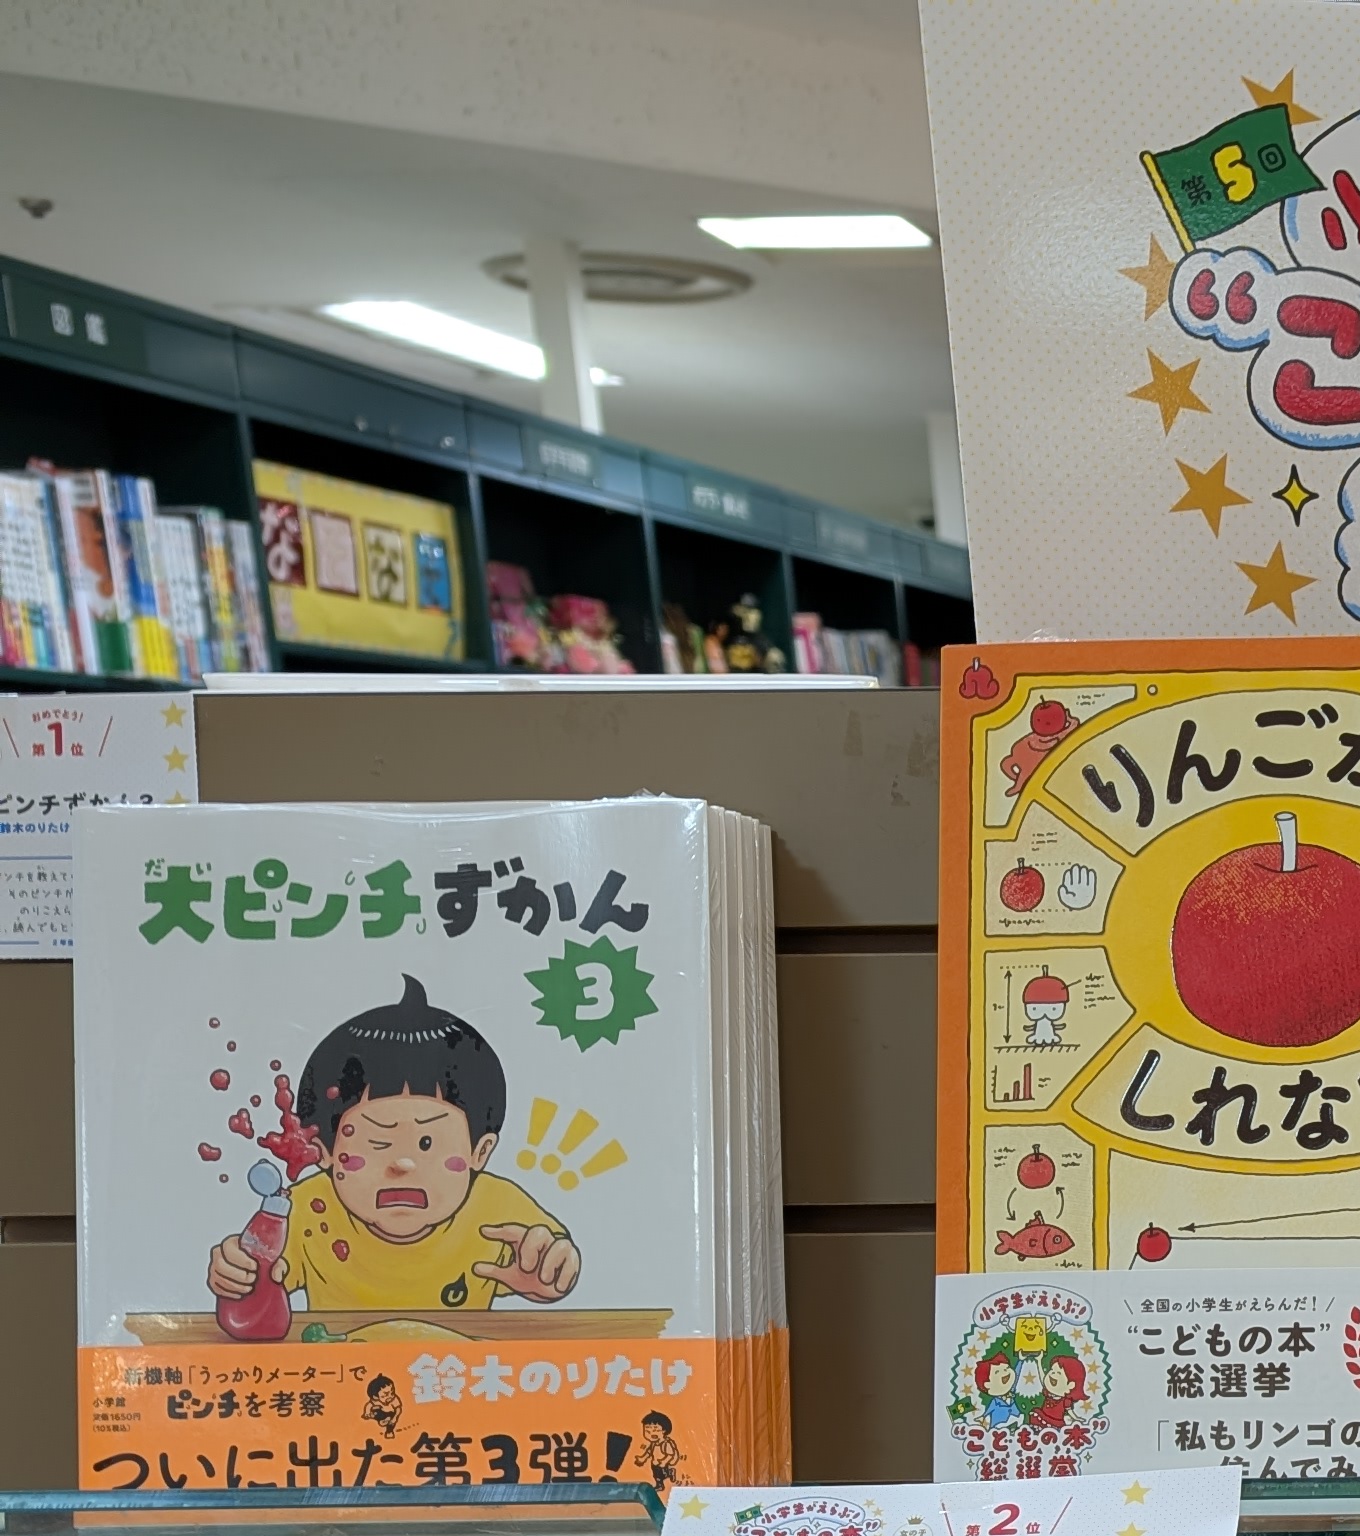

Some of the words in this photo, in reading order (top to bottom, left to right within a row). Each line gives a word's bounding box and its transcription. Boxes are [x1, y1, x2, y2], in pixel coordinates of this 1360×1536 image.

[32, 722, 84, 757] 第1位
[139, 857, 650, 945] 大ピンチずかん
[574, 962, 615, 1021] 3
[1140, 1297, 1320, 1315] 全国の小学生がえらんだ!
[1128, 1322, 1332, 1359] “こどもの本”
[408, 1353, 693, 1405] 鈴木のりたけ
[1166, 1363, 1293, 1400] 総選挙
[166, 1389, 327, 1421] ピンチを考察
[965, 1503, 1041, 1536] 第2位
